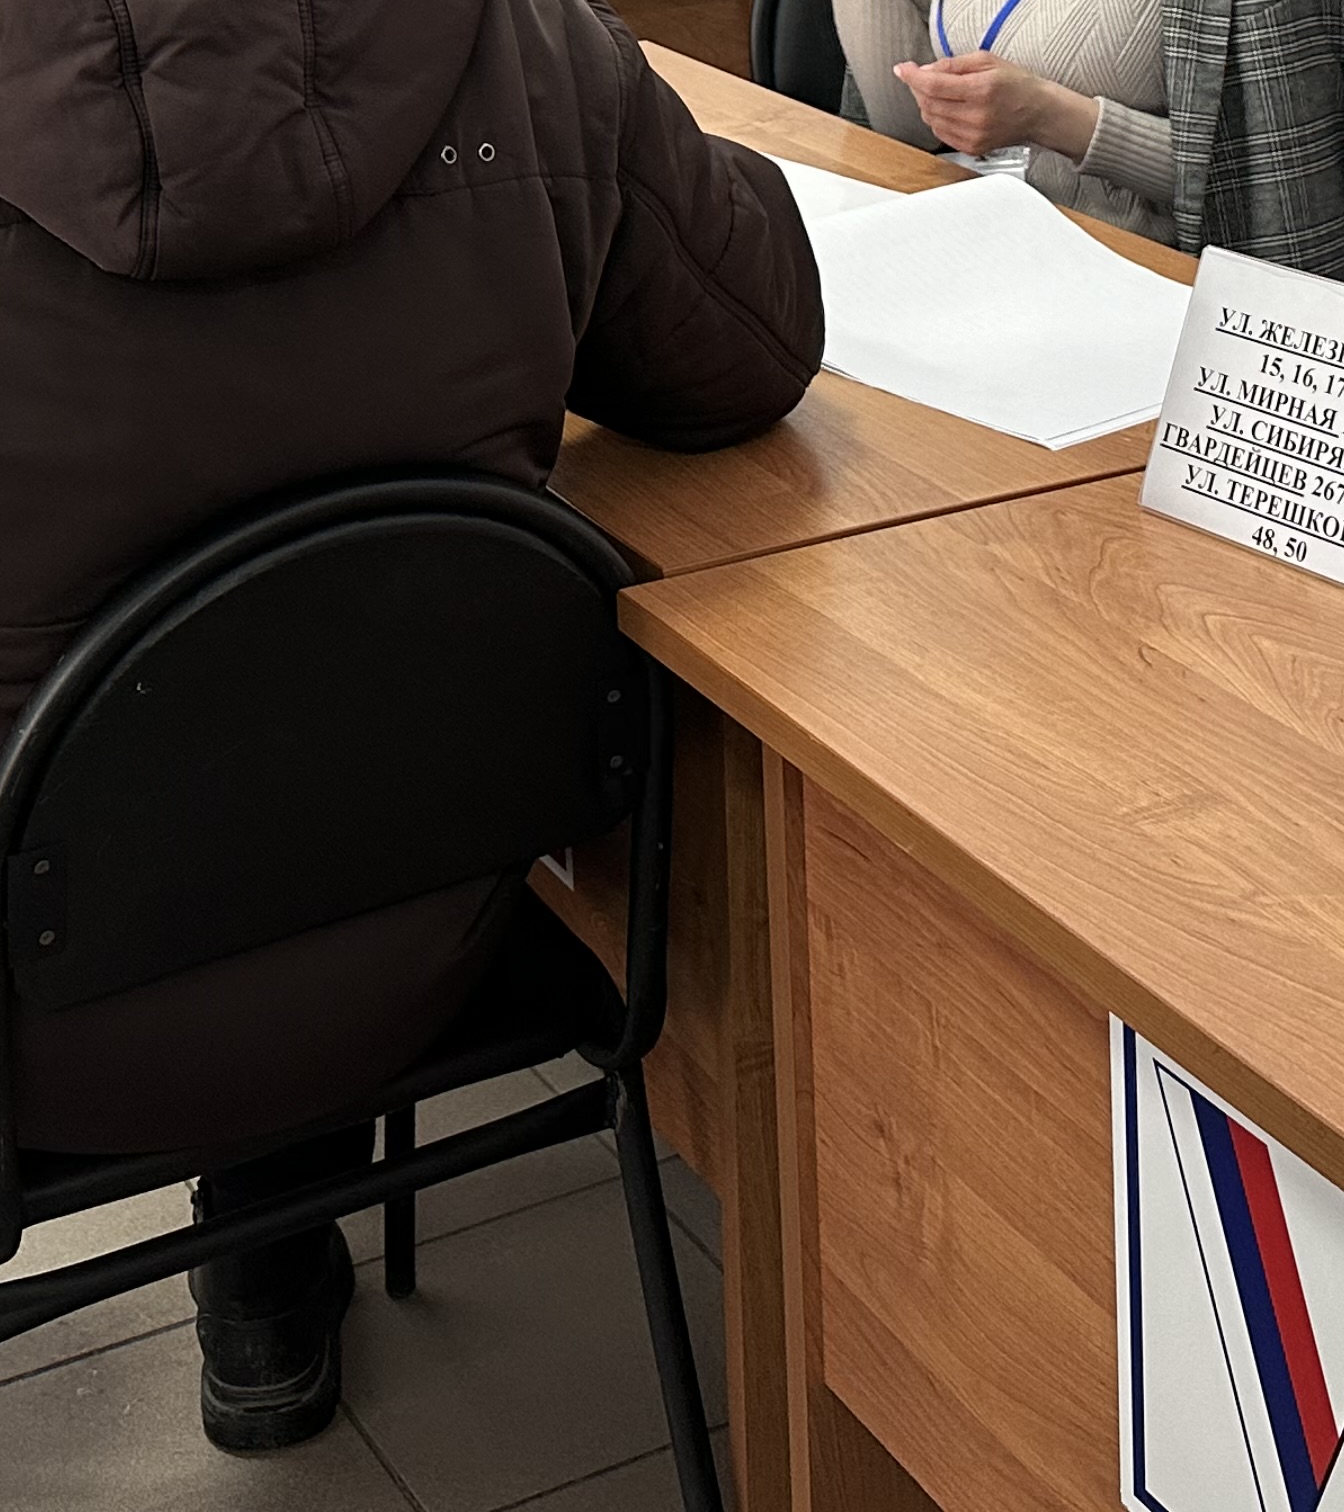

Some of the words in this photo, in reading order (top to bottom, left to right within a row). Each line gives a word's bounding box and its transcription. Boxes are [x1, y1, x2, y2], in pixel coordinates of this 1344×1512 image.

[1218, 307, 1254, 337] УЛ.
[1260, 354, 1287, 383] 15,
[1291, 364, 1319, 393] 16,
[1196, 367, 1232, 397] УЛ.
[1236, 379, 1340, 431] МИРНАЯ
[1209, 405, 1245, 436] УЛ.
[1161, 422, 1308, 492] ГВАРДЕЙЦЕВ
[1183, 464, 1219, 496] УЛ.
[1251, 525, 1278, 556] 48,
[1284, 540, 1308, 564] 50
